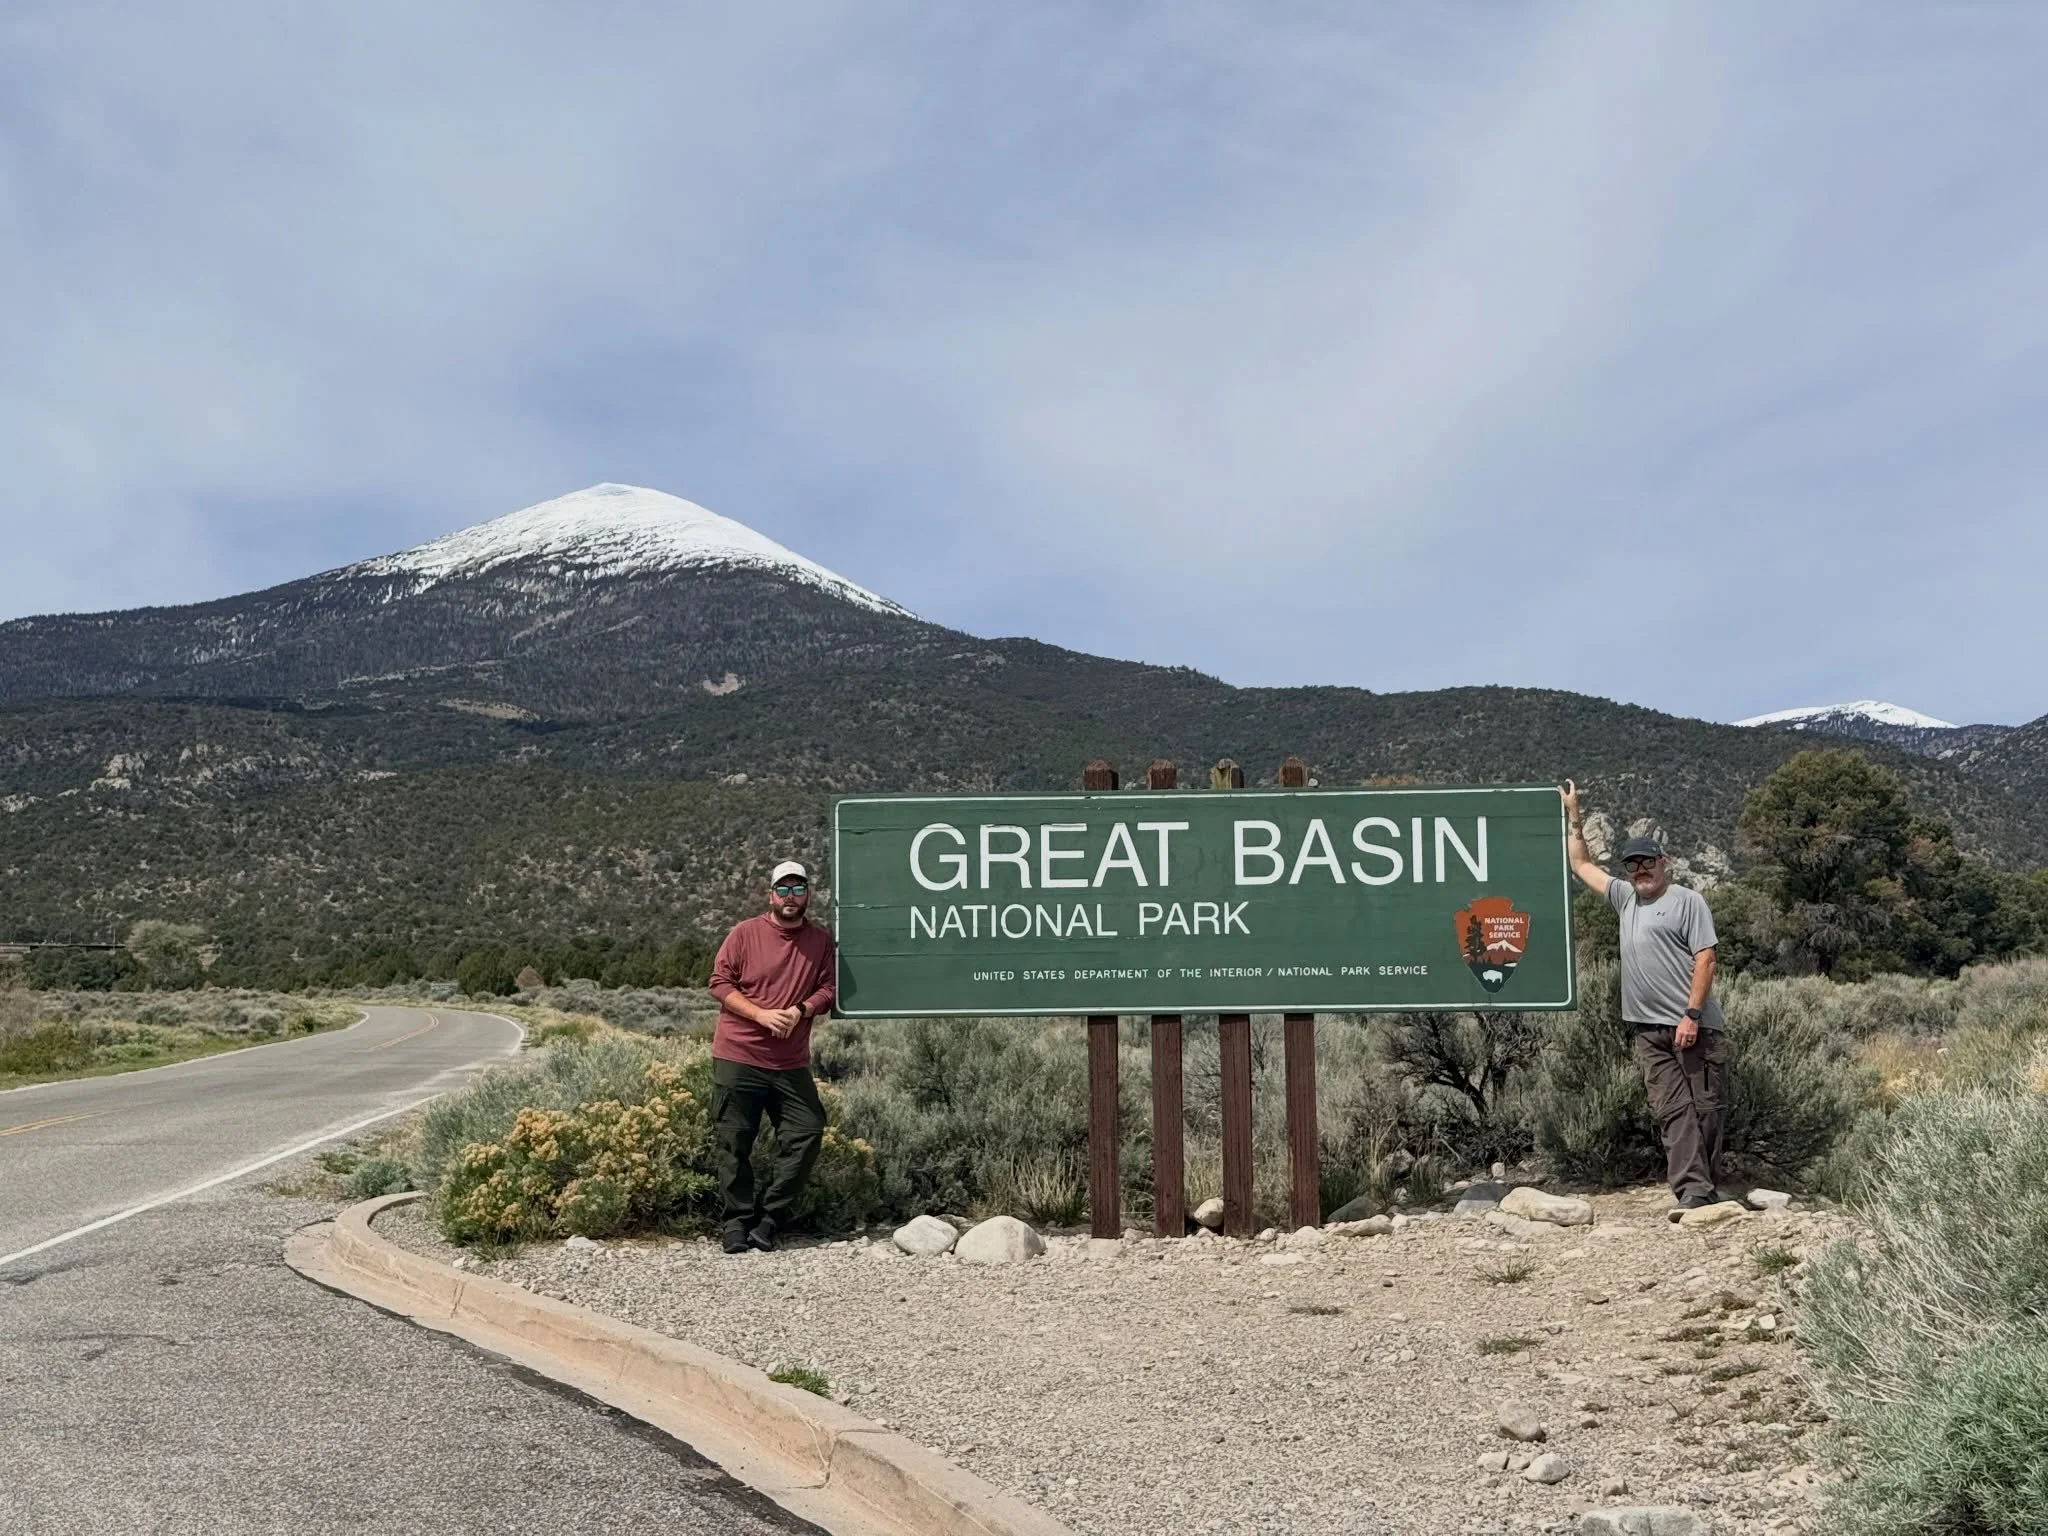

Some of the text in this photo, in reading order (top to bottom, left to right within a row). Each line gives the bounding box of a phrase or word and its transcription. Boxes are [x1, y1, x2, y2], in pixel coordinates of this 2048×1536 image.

[909, 816, 1488, 891] GREAT BASIN
[910, 901, 1251, 939] NATIONAL PARK
[973, 970, 1015, 981] UNITED
[1023, 970, 1066, 980] STATES
[1074, 968, 1149, 980] DEPARTMENT
[1157, 968, 1172, 979] OF
[1179, 968, 1202, 978] THE
[1209, 967, 1262, 977] INTERIOR
[1277, 966, 1333, 977] NATIONAL
[1341, 966, 1371, 976] PARK
[1378, 965, 1428, 976] SERVICE
